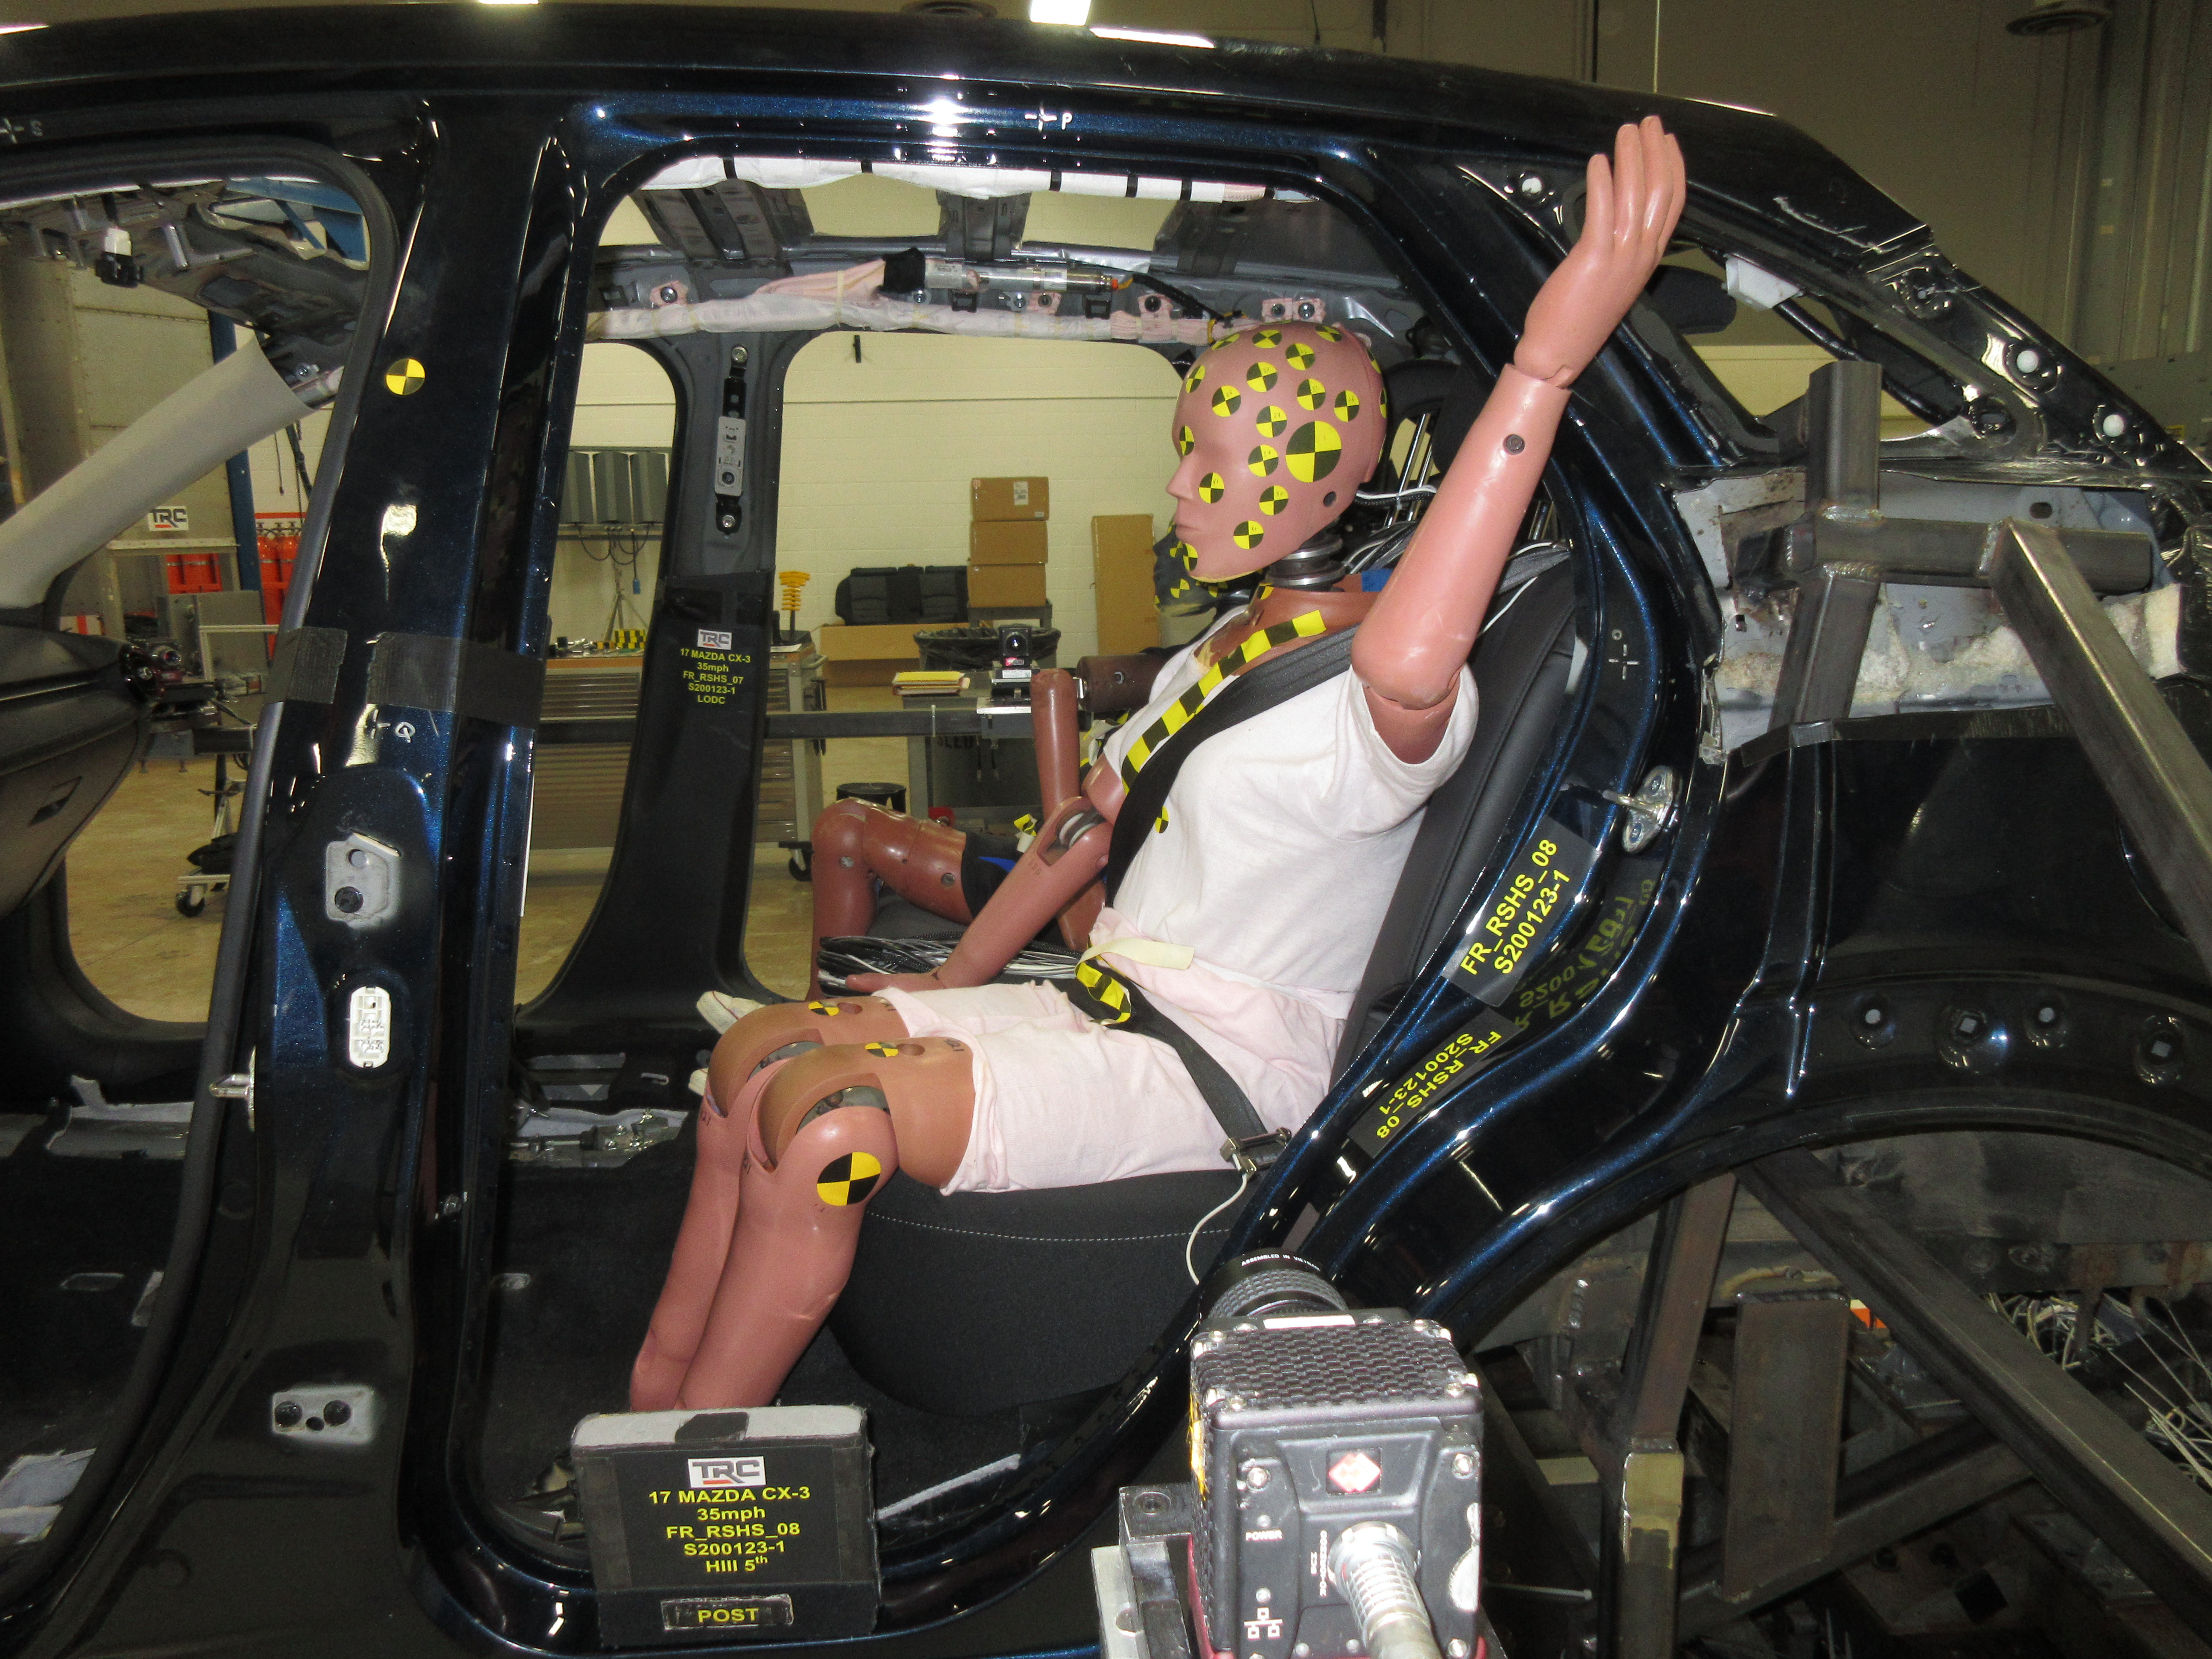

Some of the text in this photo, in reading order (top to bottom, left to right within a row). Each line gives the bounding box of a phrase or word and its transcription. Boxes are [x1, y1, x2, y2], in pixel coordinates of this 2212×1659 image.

[1062, 113, 1072, 130] P
[150, 509, 187, 528] TRC
[700, 631, 730, 647] TRC
[680, 648, 751, 664] 17 MAZDA CX-3
[697, 662, 729, 673] 35mph
[683, 670, 744, 685] FR_RSHS_07
[688, 683, 736, 695] S200123-1
[698, 695, 725, 704] LODC
[395, 722, 416, 743] Q
[1460, 839, 1557, 975] FR_RSHS_08
[1494, 869, 1570, 974] S200123-1
[1379, 1033, 1473, 1115] S200123-1
[1376, 1031, 1502, 1138] FR_RSHS_08
[1241, 1254, 1280, 1267] ASSEMBLED
[692, 1459, 760, 1483] TRC
[649, 1486, 810, 1504] 17 MAZDA CX-3
[697, 1506, 765, 1522] 35mph
[666, 1522, 800, 1541] FR_RSHS_08
[1246, 1529, 1283, 1541] POWER
[684, 1540, 785, 1556] S200123-1
[745, 1555, 768, 1572] 5th
[698, 1607, 759, 1623] POST
